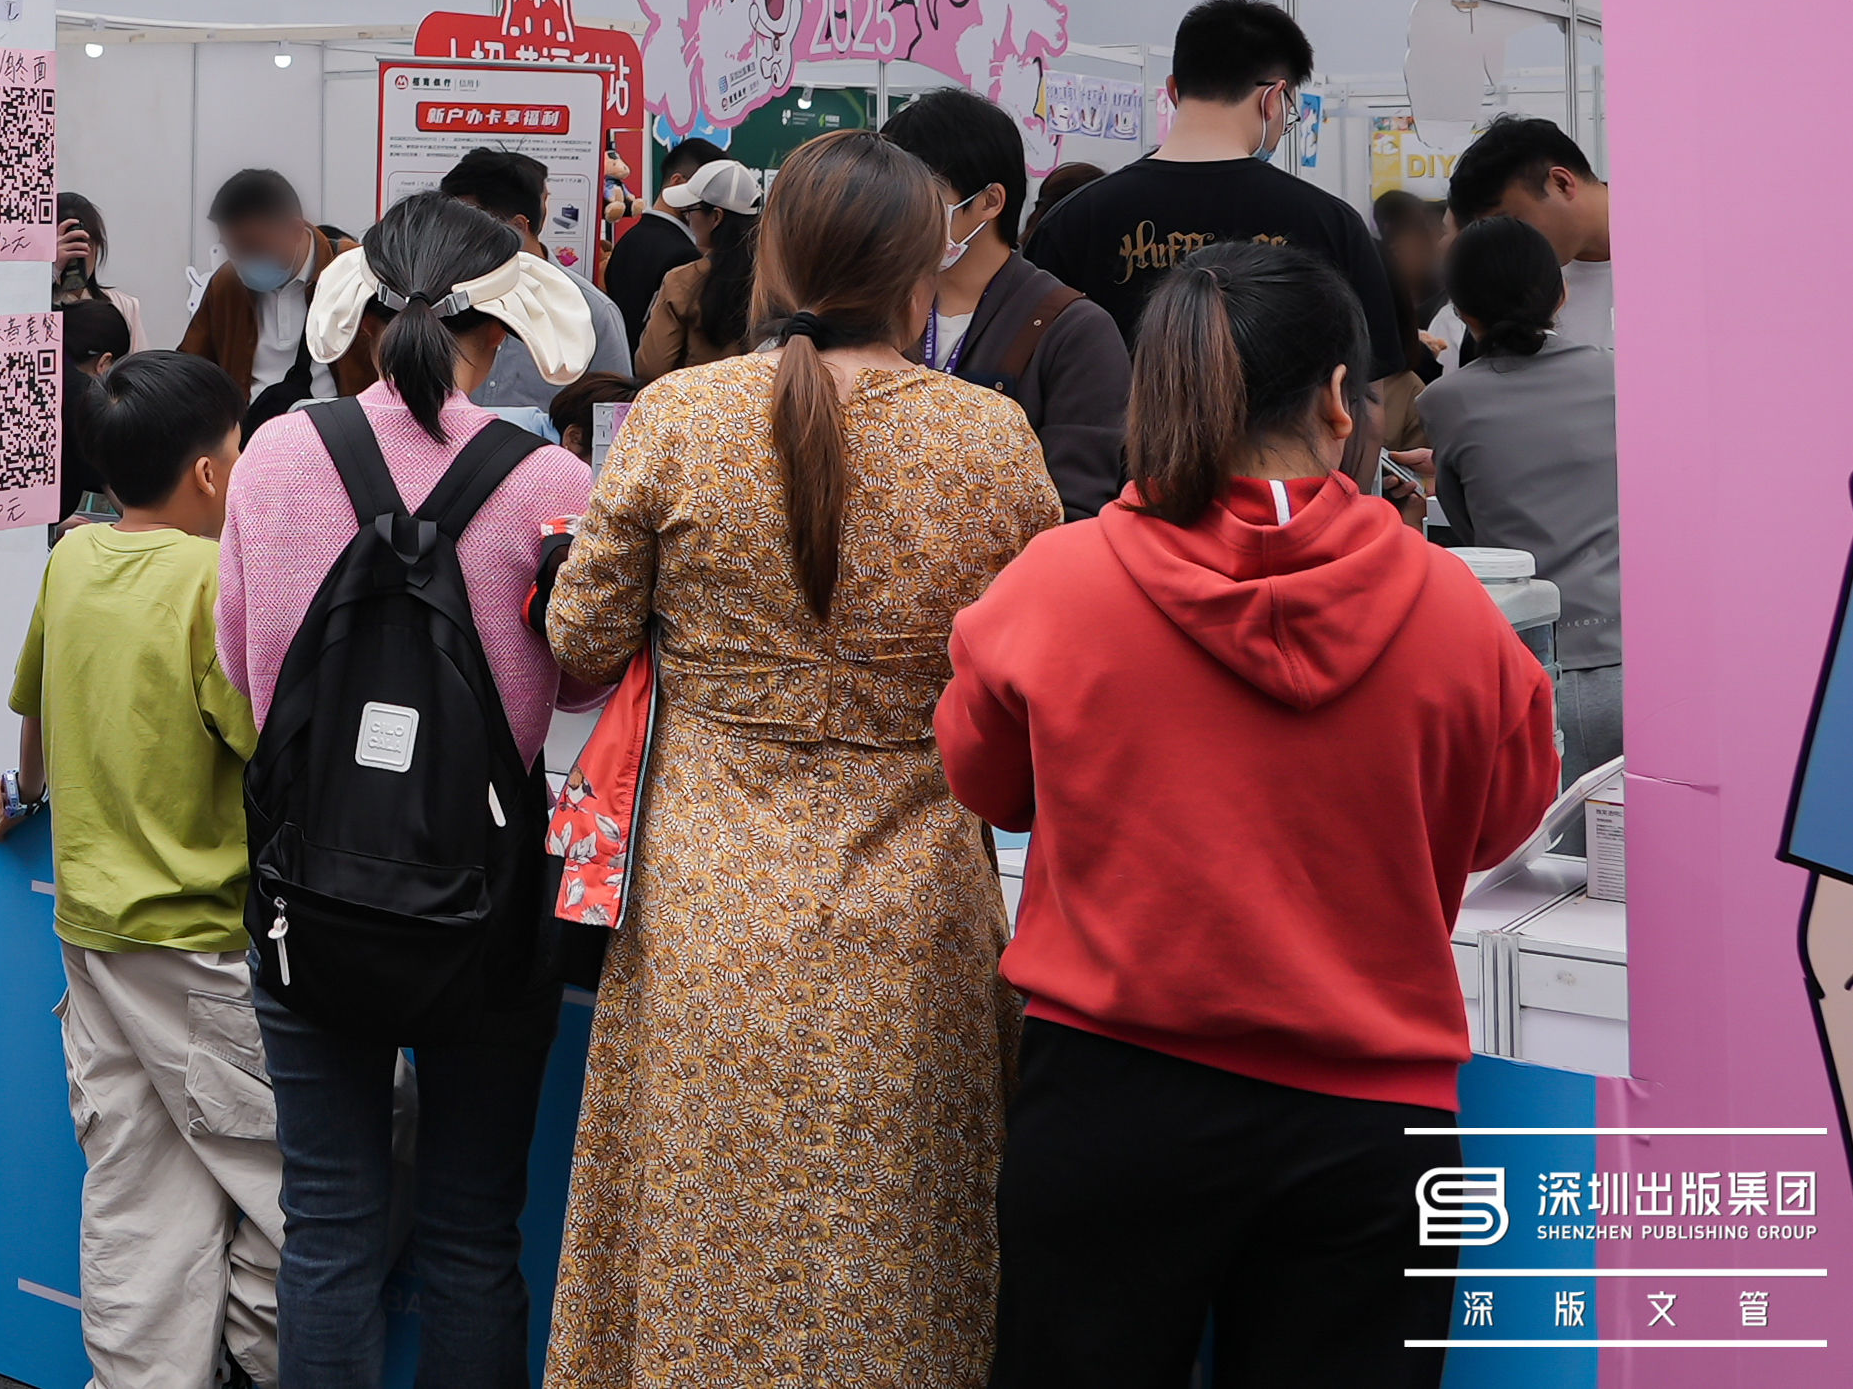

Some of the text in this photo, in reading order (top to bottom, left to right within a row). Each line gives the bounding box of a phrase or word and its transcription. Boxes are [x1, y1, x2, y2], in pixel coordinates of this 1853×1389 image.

[426, 107, 561, 128] 新户办卡享福利
